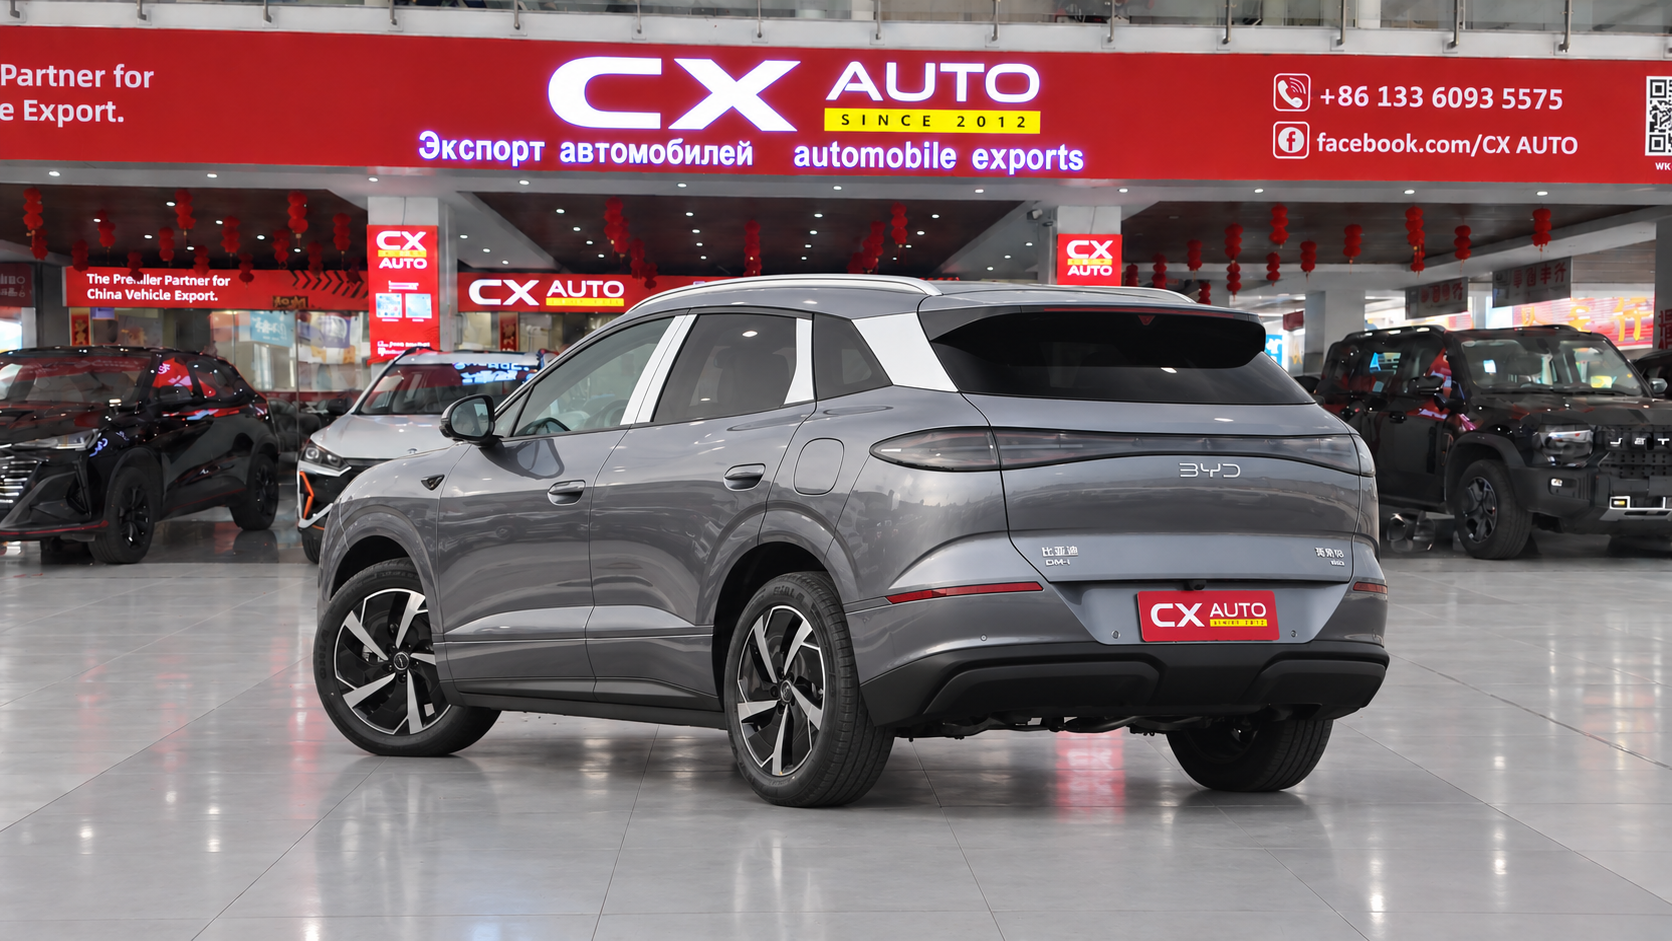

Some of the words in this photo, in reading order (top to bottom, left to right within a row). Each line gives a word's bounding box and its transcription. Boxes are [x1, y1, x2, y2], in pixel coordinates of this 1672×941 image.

[1, 64, 105, 87] Partner
[114, 64, 154, 87] for
[548, 57, 800, 131] CX
[826, 61, 1039, 103] AUTO
[1321, 86, 1368, 106] +86
[1378, 86, 1423, 107] 133
[1433, 87, 1493, 108] 6093
[1502, 88, 1562, 109] 5575
[24, 100, 123, 127] Export.
[842, 114, 930, 126] SINCE
[958, 116, 1024, 127] 2012
[419, 130, 545, 166] Экспорт
[560, 138, 752, 165] автомобилей
[1317, 133, 1510, 157] facebook.com/CX
[1516, 137, 1577, 154] AUTO
[794, 141, 956, 169] automobile
[972, 144, 1083, 175] exports
[377, 231, 426, 250] CX
[1067, 240, 1113, 259] CX
[379, 257, 427, 269] AUTO
[1068, 265, 1112, 276] AUTO
[87, 274, 110, 284] The
[165, 276, 210, 286] Partner
[212, 275, 230, 286] for
[87, 288, 122, 299] China
[125, 289, 171, 300] Vehicle
[175, 290, 218, 303] Export.
[469, 280, 539, 305] CX
[547, 280, 624, 297] AUTO
[1178, 462, 1241, 477] BYD
[1151, 603, 1204, 627] CX
[1210, 603, 1266, 617] AUTO
